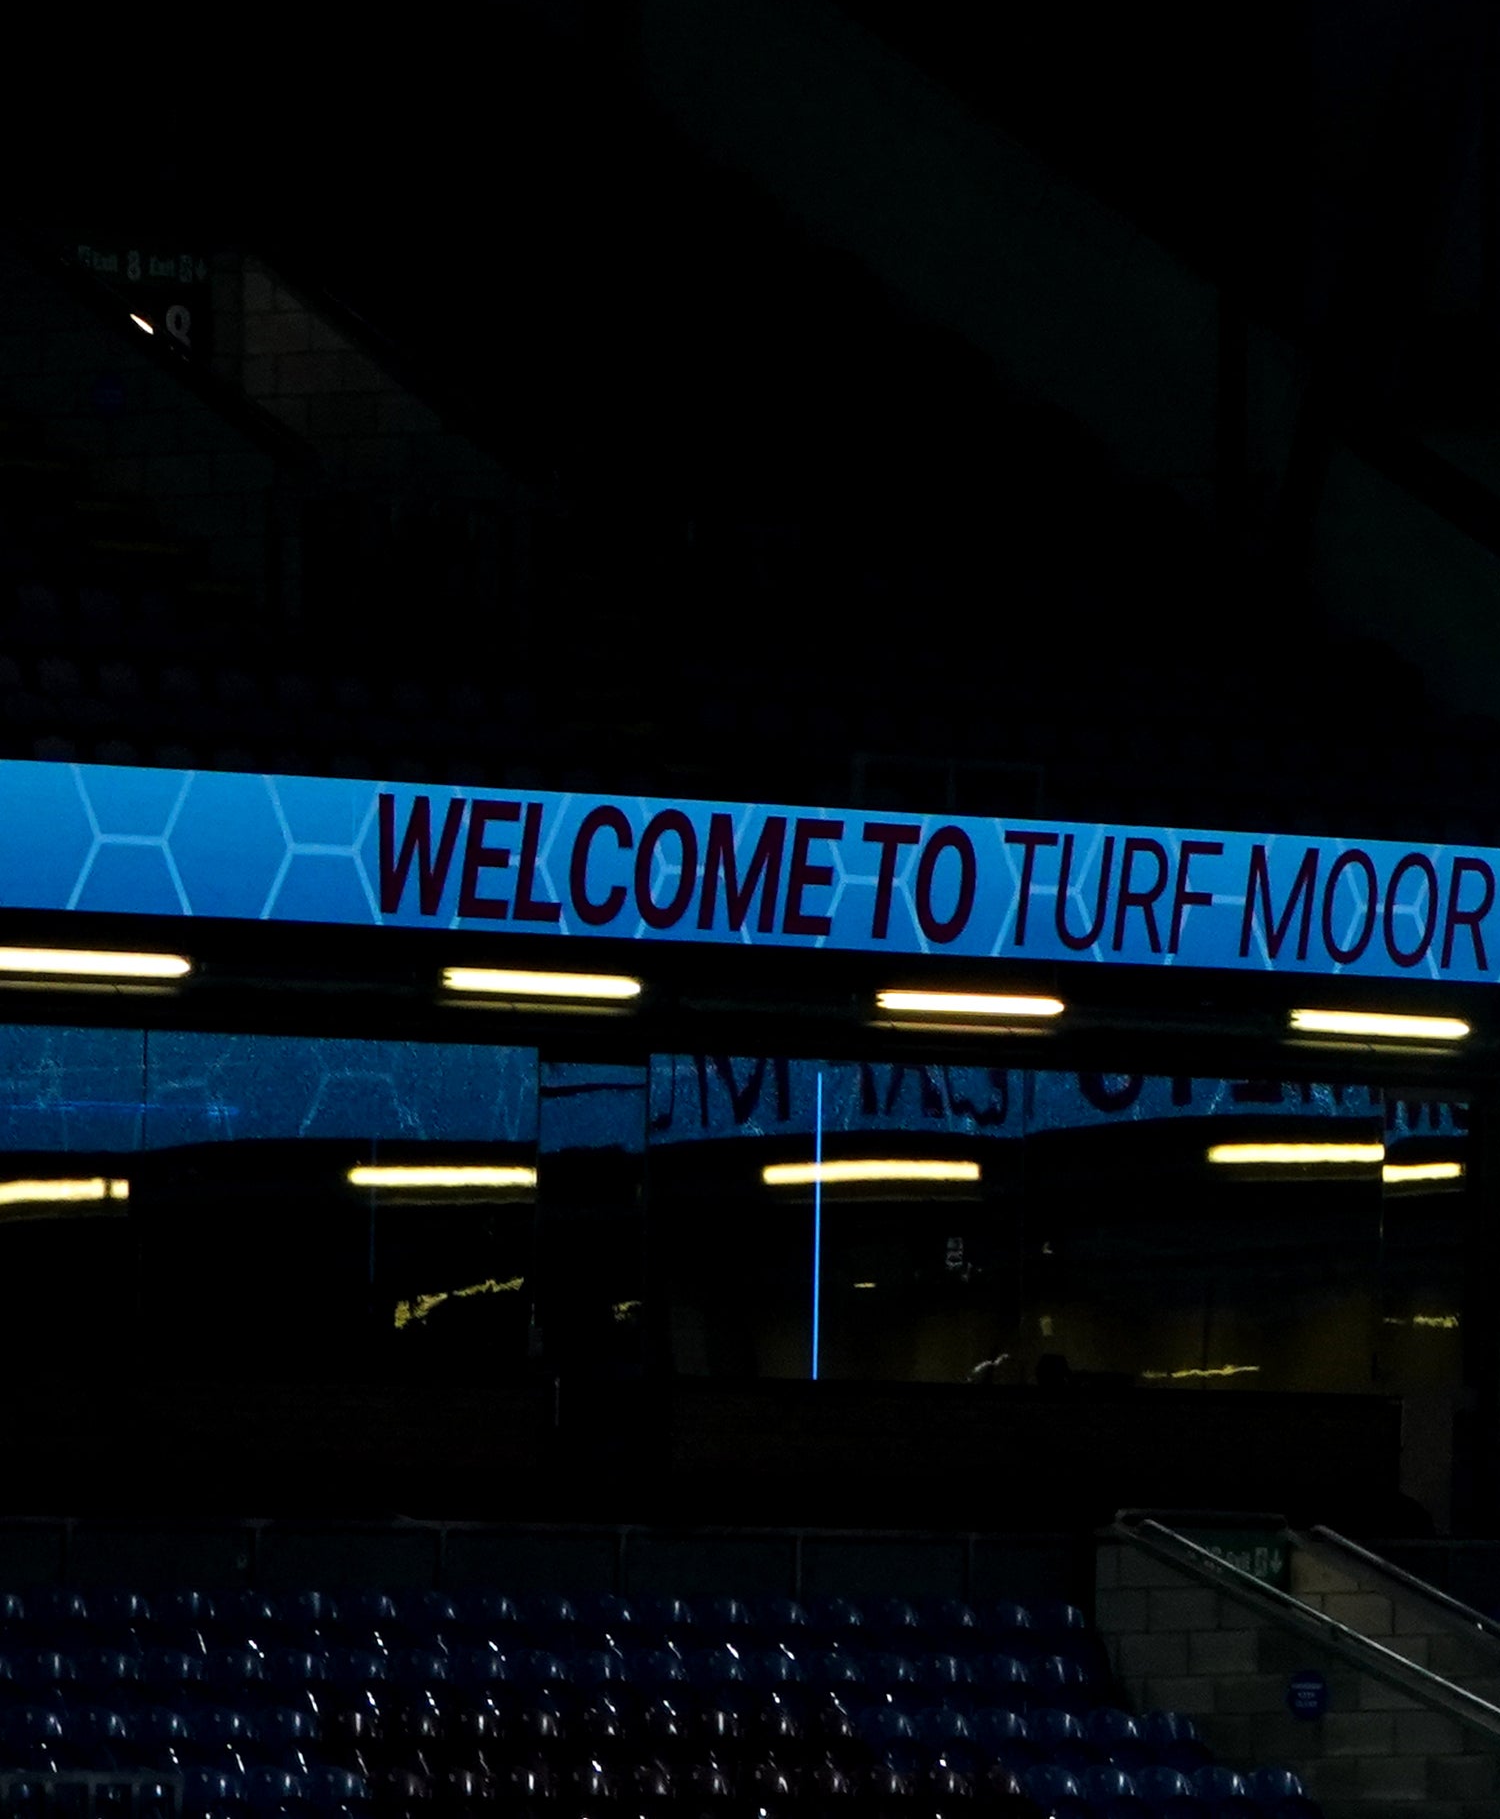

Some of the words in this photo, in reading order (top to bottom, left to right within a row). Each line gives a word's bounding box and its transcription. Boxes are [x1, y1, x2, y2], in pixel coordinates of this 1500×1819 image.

[378, 793, 844, 937] WELCOME
[862, 822, 977, 945] TO
[1004, 830, 1224, 955] TURF
[1238, 844, 1495, 972] MOOR
